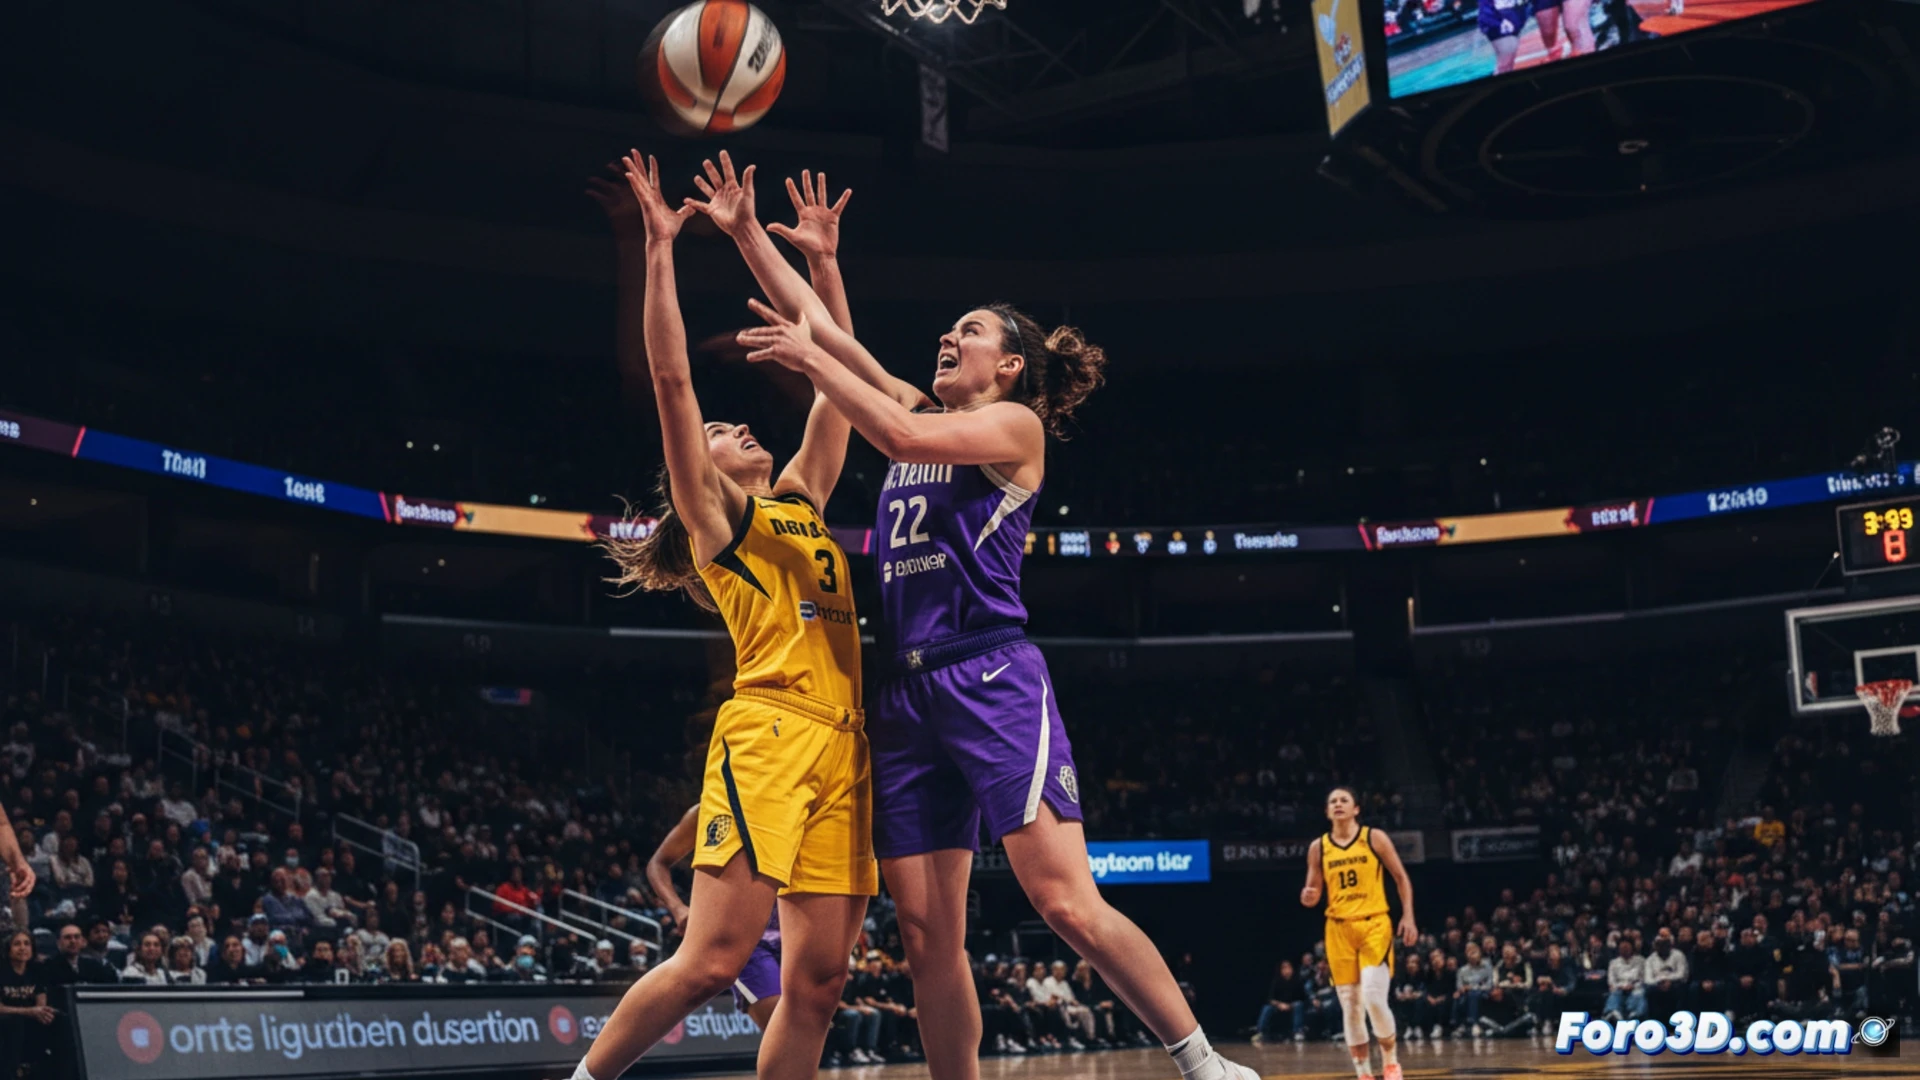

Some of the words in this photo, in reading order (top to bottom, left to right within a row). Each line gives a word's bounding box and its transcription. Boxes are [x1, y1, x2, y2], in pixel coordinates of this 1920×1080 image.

[889, 494, 930, 549] 22
[1884, 529, 1906, 562] 8
[815, 549, 838, 593] 3
[1338, 869, 1358, 889] 18
